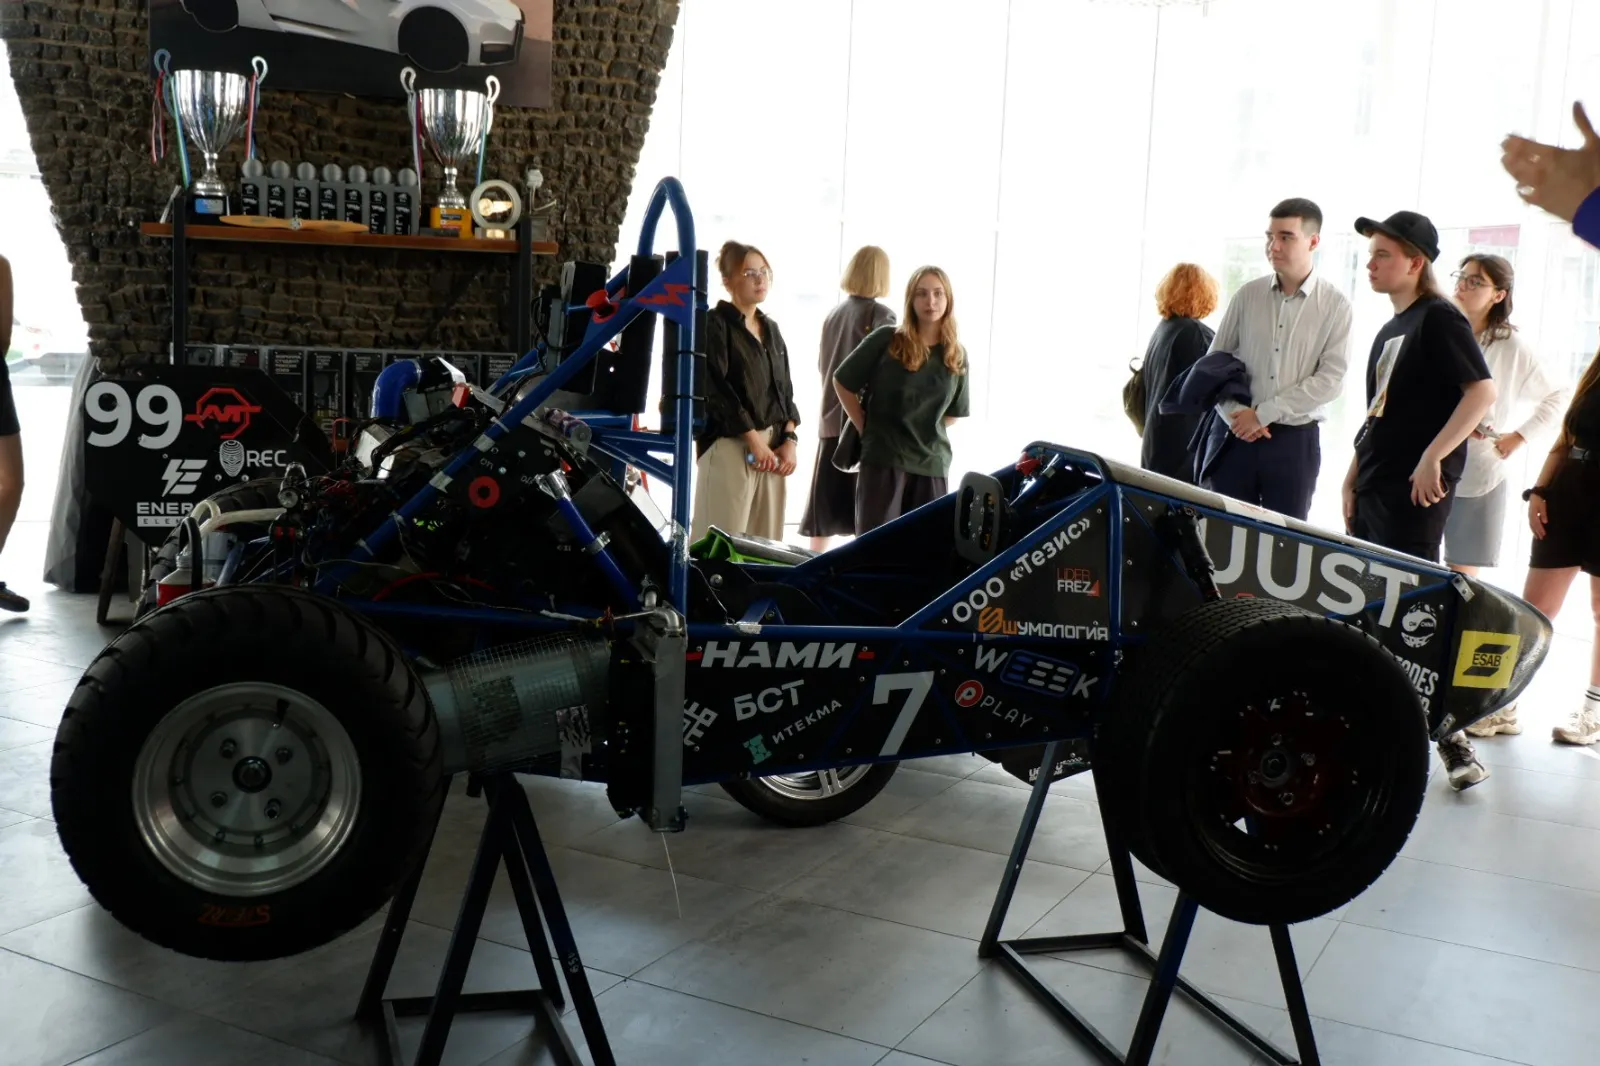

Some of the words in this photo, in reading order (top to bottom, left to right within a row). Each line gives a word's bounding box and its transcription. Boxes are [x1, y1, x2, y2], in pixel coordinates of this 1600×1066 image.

[85, 382, 183, 450] 99
[246, 450, 288, 468] REC
[136, 502, 194, 515] ENER
[952, 576, 1006, 623] ООО
[1010, 517, 1091, 582] «Тезис»
[1057, 579, 1097, 595] FREZ
[1003, 620, 1110, 642] ШУМОЛОГИЯ
[701, 640, 858, 669] НАМИ
[1472, 653, 1503, 667] ESAB
[734, 679, 805, 722] БСТ
[872, 670, 936, 758] 7
[979, 694, 1034, 728] PLAY
[771, 699, 844, 746] ИТЕКМА
